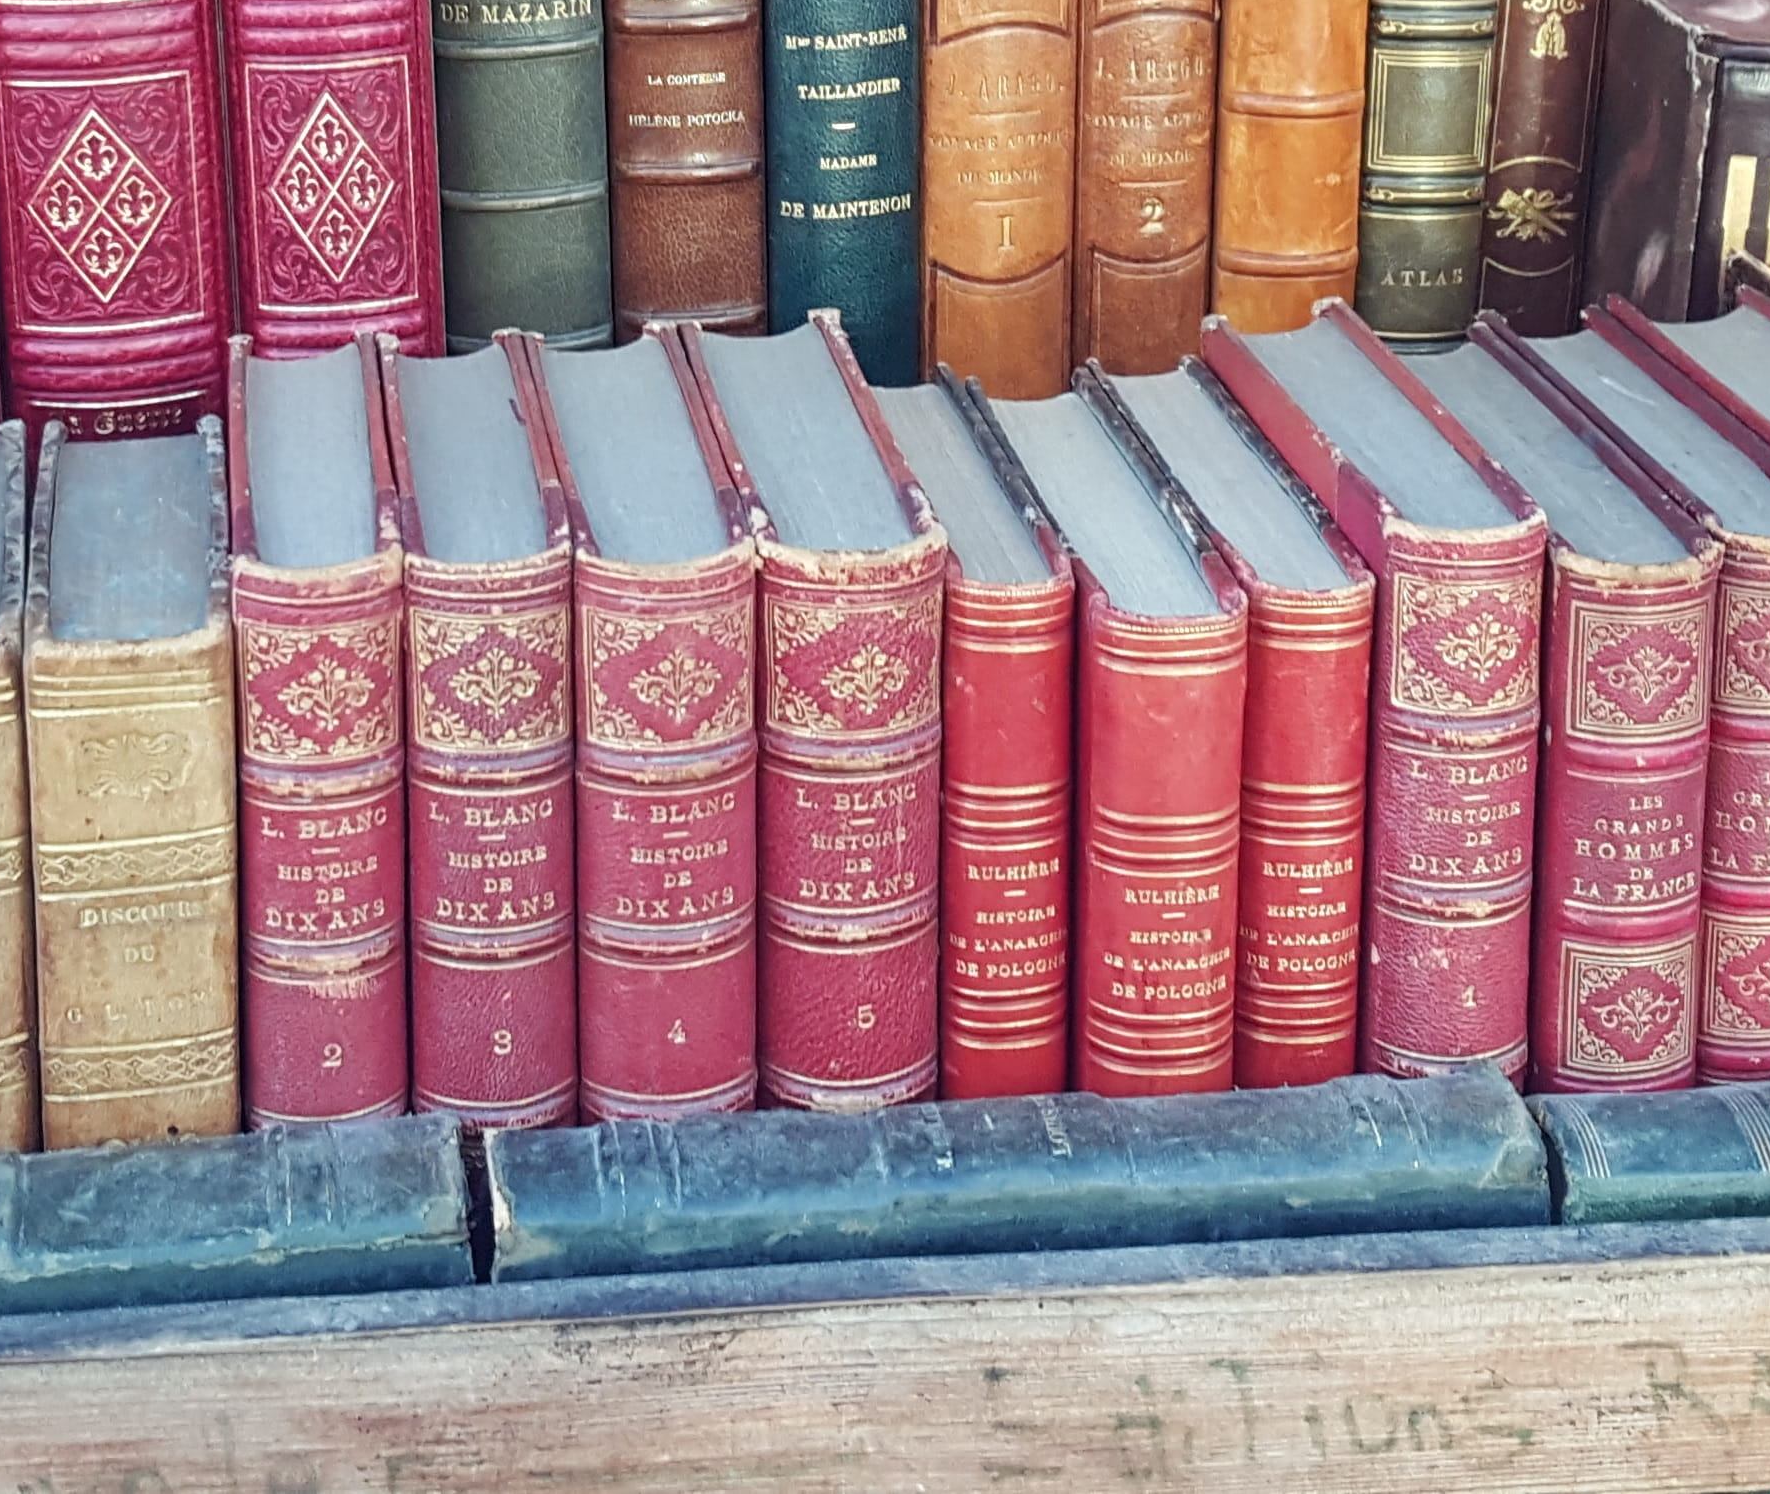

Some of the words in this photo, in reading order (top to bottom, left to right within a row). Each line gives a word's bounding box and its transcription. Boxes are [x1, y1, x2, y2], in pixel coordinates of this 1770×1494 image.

[440, 2, 470, 24] DE
[647, 73, 664, 86] LA
[667, 71, 727, 87] COMTESSE
[797, 77, 903, 101] TAILLANDIER
[820, 154, 879, 170] MADAME
[780, 201, 806, 218] DE
[812, 193, 913, 220] MAINTENON
[1137, 196, 1167, 236] 2
[1380, 267, 1464, 288] ATLAS
[1410, 758, 1433, 782] L.
[1447, 755, 1530, 787] BLANC
[428, 802, 452, 824] L.
[462, 799, 553, 827] BLANC
[1425, 800, 1523, 825] HISTOIRE
[1630, 793, 1664, 813] LES
[1593, 813, 1685, 838] GRANDS
[1464, 830, 1492, 847] DE
[1574, 832, 1696, 863] HOMMES
[447, 845, 548, 870] HISTOIRE
[1408, 851, 1463, 876] DIX
[1469, 848, 1524, 876] ANS
[1629, 865, 1655, 881] DE
[483, 877, 513, 895] DE
[1123, 884, 1221, 905] RULHIÈRE
[1571, 876, 1605, 900] LA
[1615, 870, 1697, 902] FRANCE
[436, 897, 489, 922] DIX
[498, 891, 557, 920] ANS
[1129, 929, 1213, 946] HISTOIRE
[121, 945, 155, 964] DU
[1111, 980, 1137, 999] DE
[1143, 975, 1227, 1001] POLOGNE
[1459, 983, 1478, 1010] 1
[492, 1029, 512, 1054] 3
